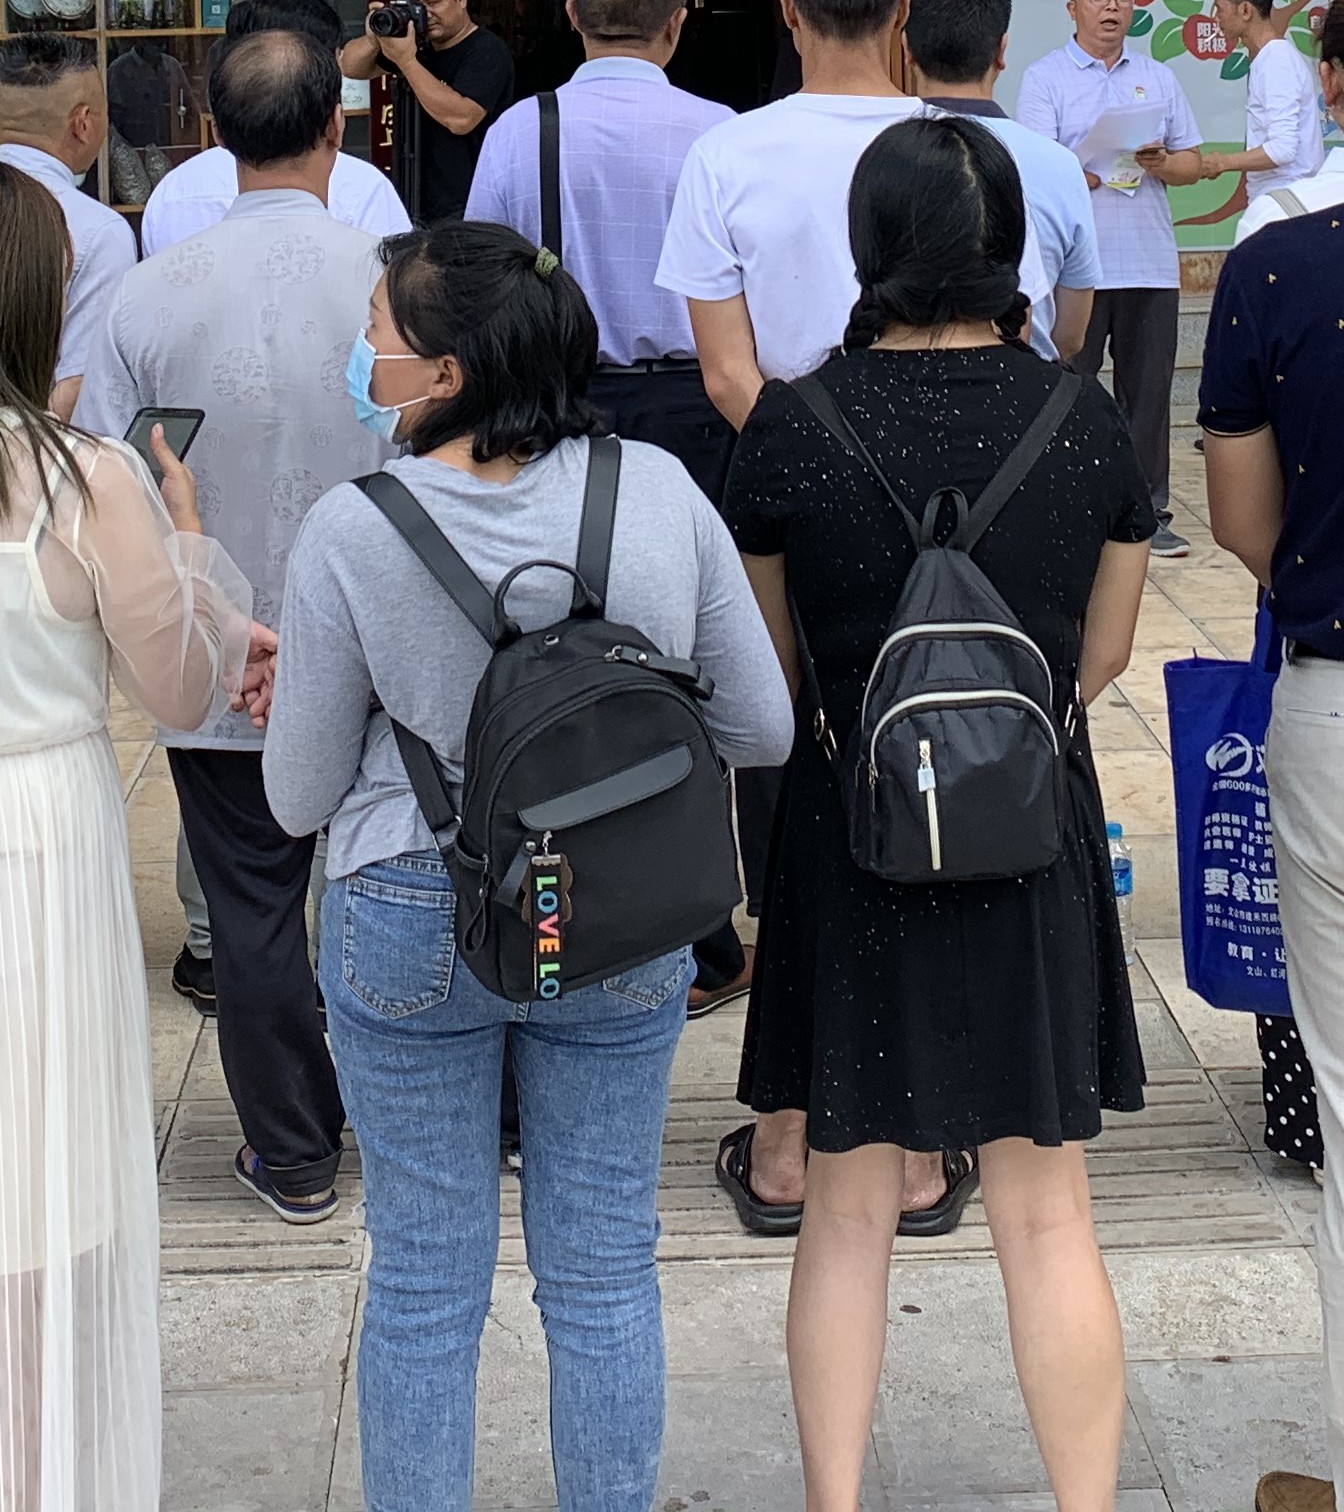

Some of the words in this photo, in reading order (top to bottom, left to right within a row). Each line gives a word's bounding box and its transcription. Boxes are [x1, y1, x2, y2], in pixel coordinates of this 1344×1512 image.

[535, 875, 561, 954] LOVE
[1203, 868, 1279, 904] 要拿证
